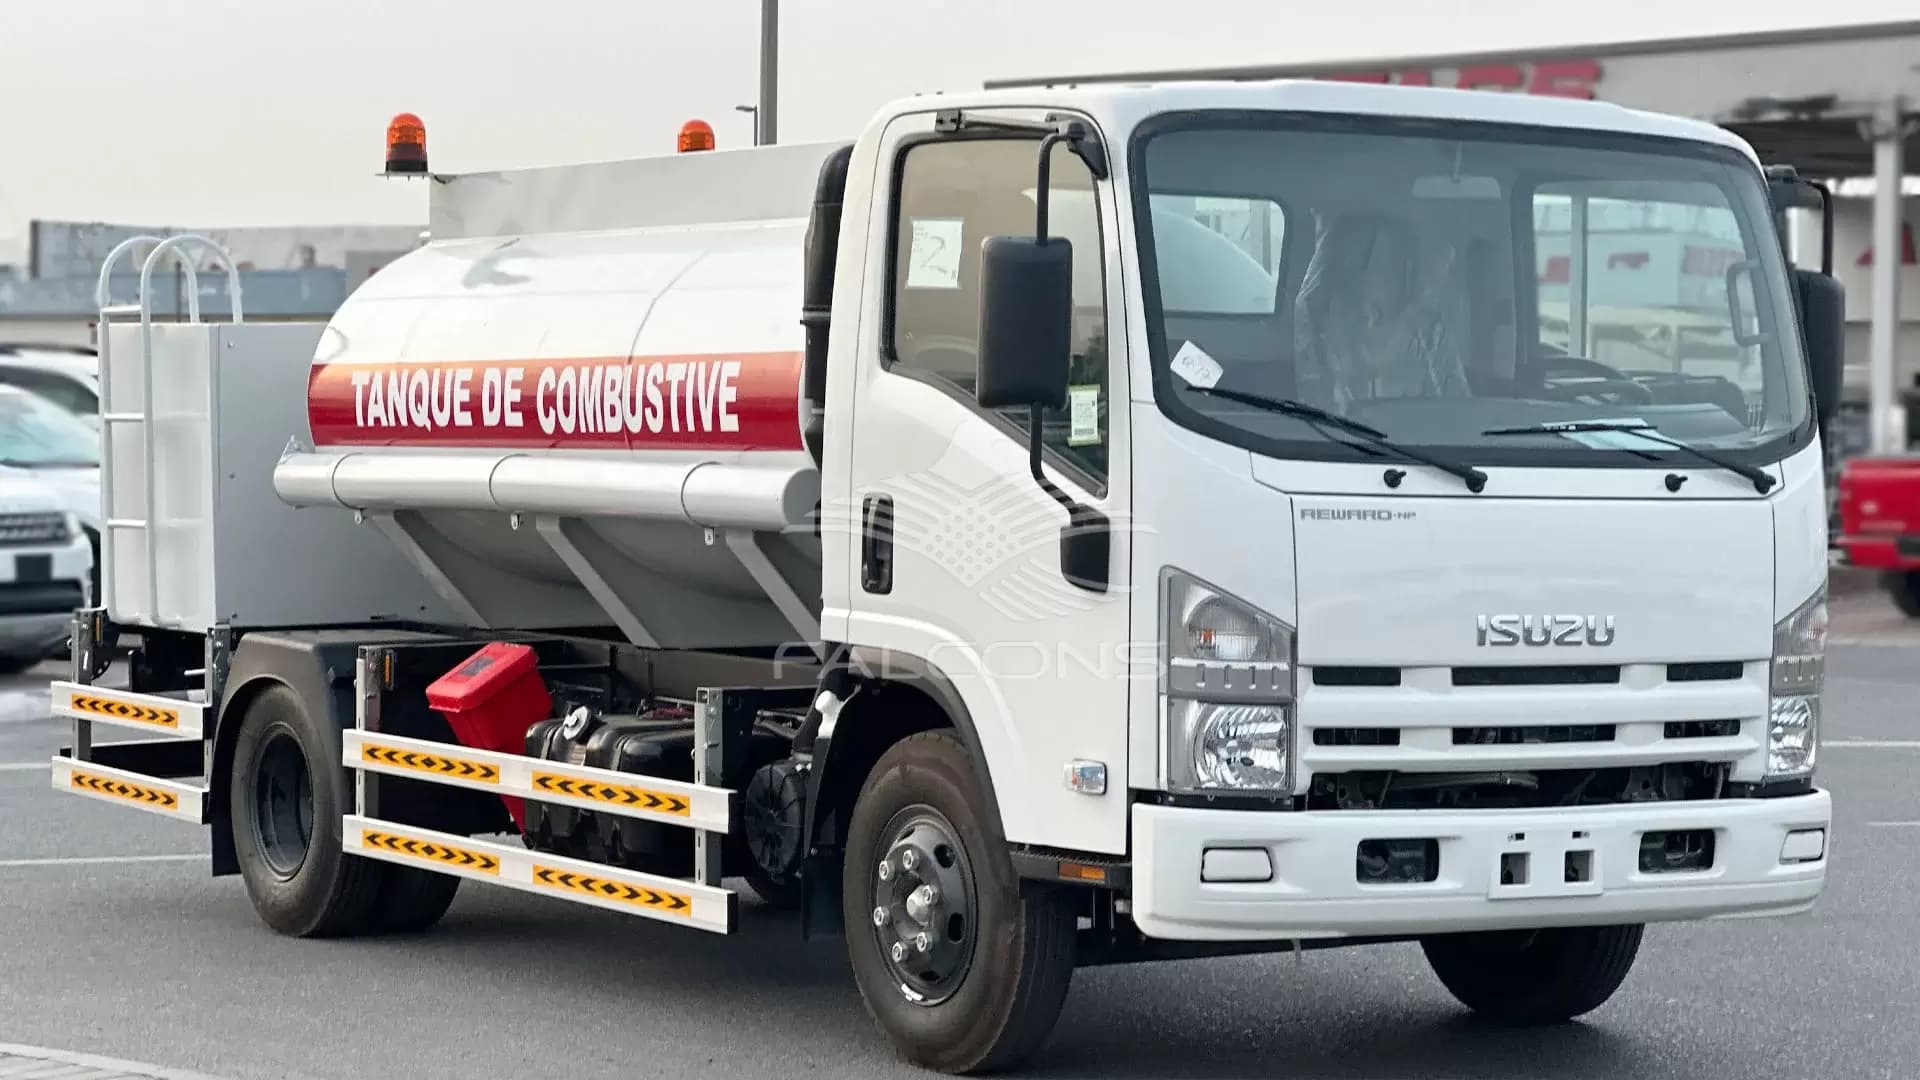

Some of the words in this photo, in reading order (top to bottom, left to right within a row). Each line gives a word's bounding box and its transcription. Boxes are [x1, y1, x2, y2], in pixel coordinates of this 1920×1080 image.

[351, 367, 473, 432] TANQUE
[481, 366, 525, 427] DE
[536, 359, 741, 434] COMBUSTIVE
[1476, 614, 1616, 647] ISUZU
